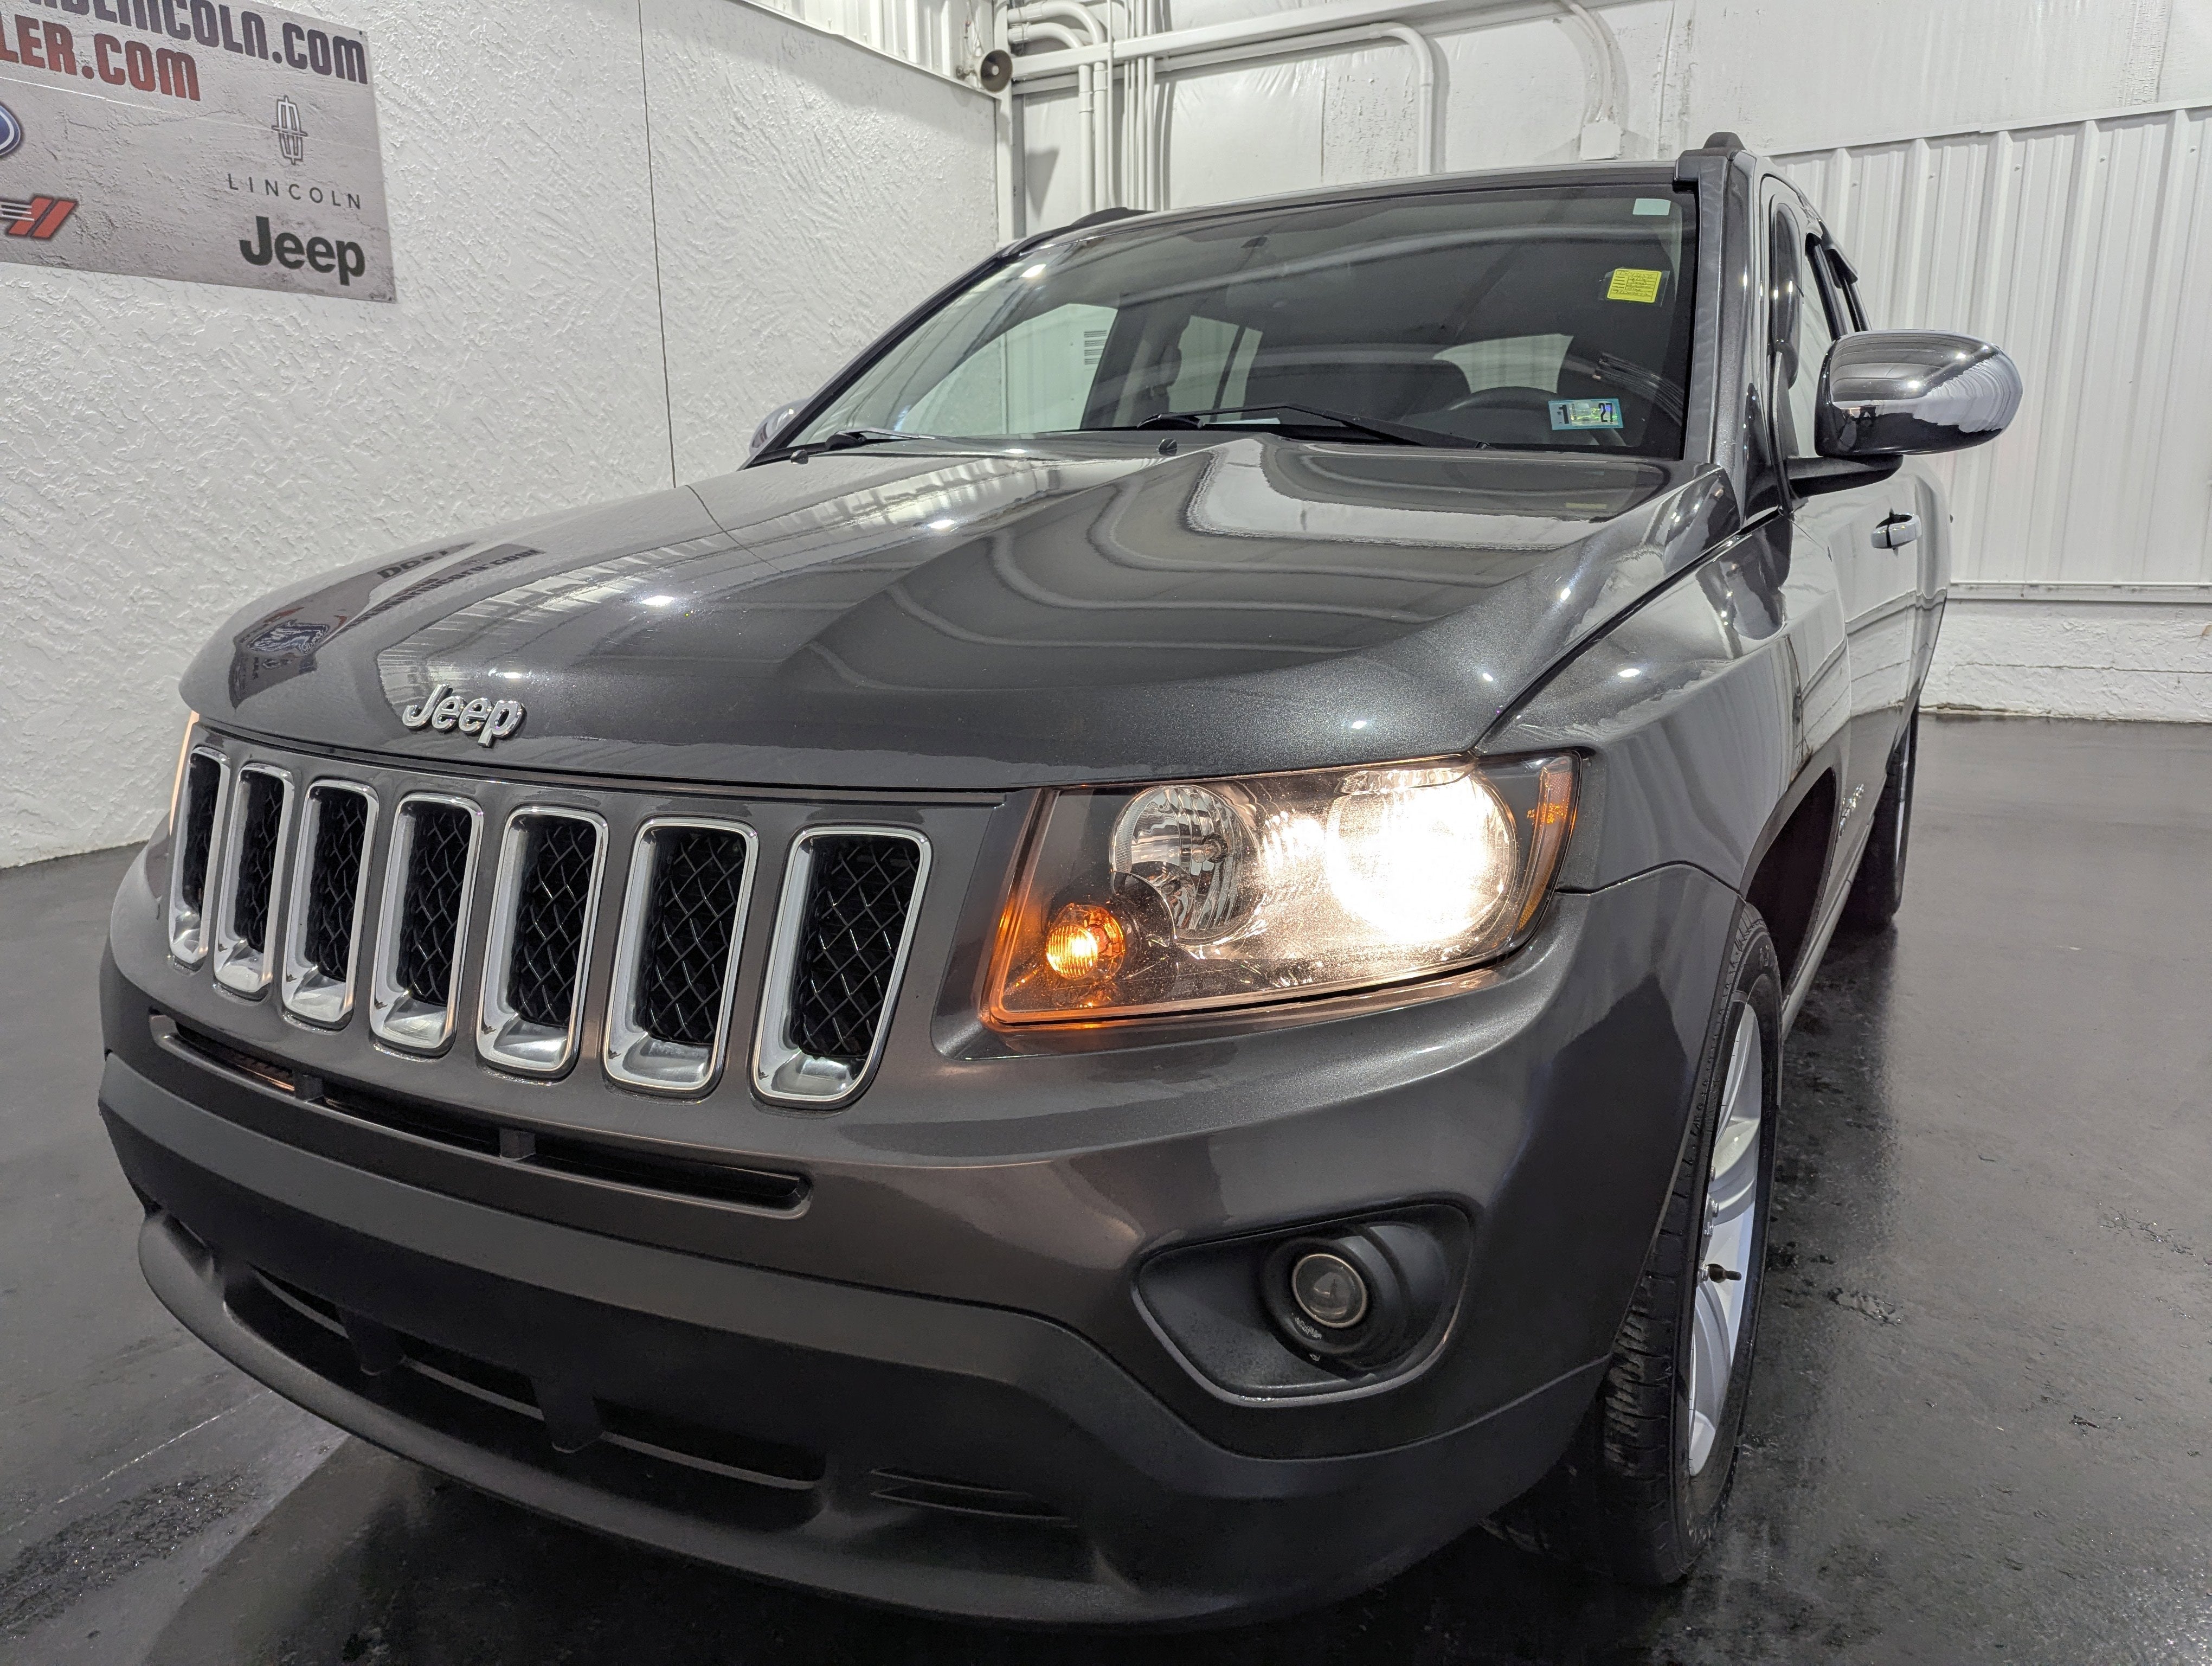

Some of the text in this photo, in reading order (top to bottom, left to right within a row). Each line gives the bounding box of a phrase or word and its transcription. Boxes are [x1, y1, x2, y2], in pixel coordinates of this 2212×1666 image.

[228, 174, 361, 209] LINCOLN
[239, 216, 365, 286] Jeep
[1598, 403, 1613, 422] 27
[402, 683, 527, 748] Jeep
